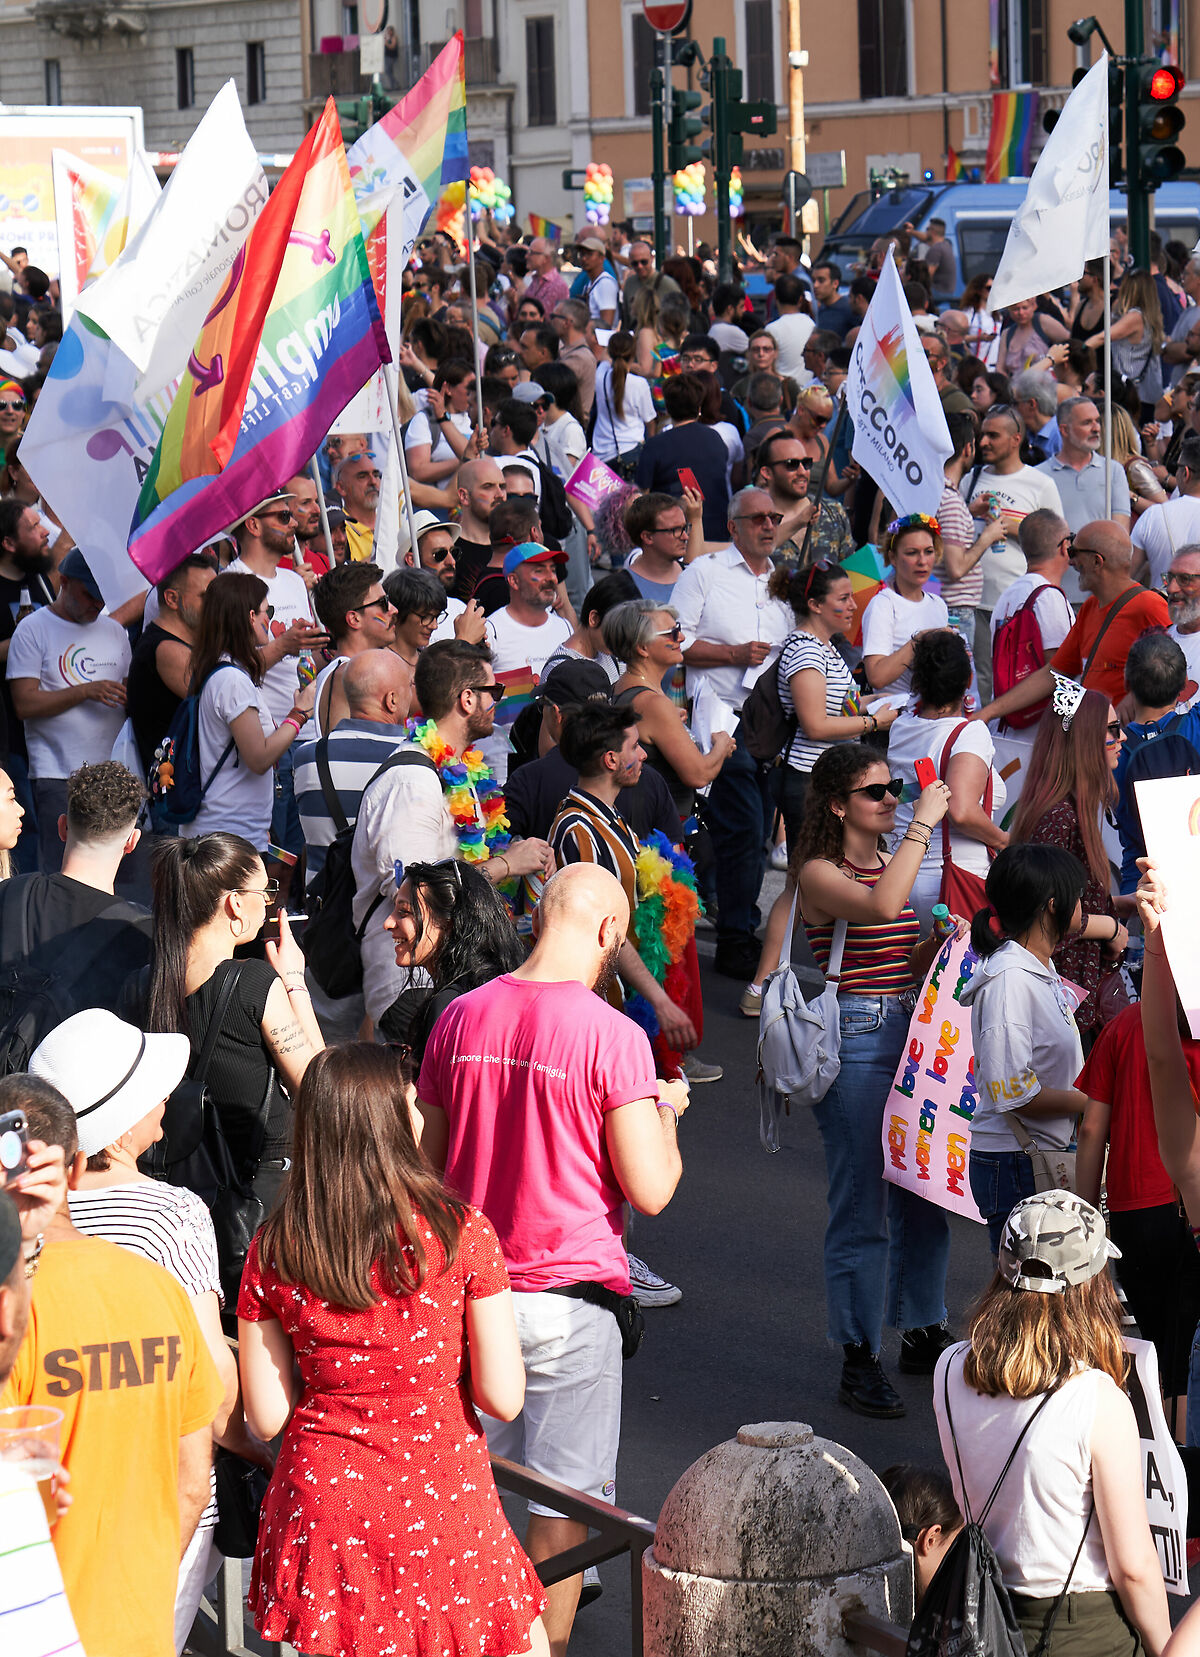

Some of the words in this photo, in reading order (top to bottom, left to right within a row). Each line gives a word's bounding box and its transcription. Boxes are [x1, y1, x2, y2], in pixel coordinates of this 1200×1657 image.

[870, 436, 895, 472] MILANO
[483, 1054, 500, 1064] che
[533, 1061, 567, 1081] famiglia
[894, 1037, 924, 1099] love
[926, 1020, 960, 1084] love
[888, 1114, 909, 1171] men
[915, 1098, 939, 1181] women
[947, 1132, 968, 1197] men
[43, 1336, 182, 1397] STAFF
[1146, 1450, 1175, 1513] A,
